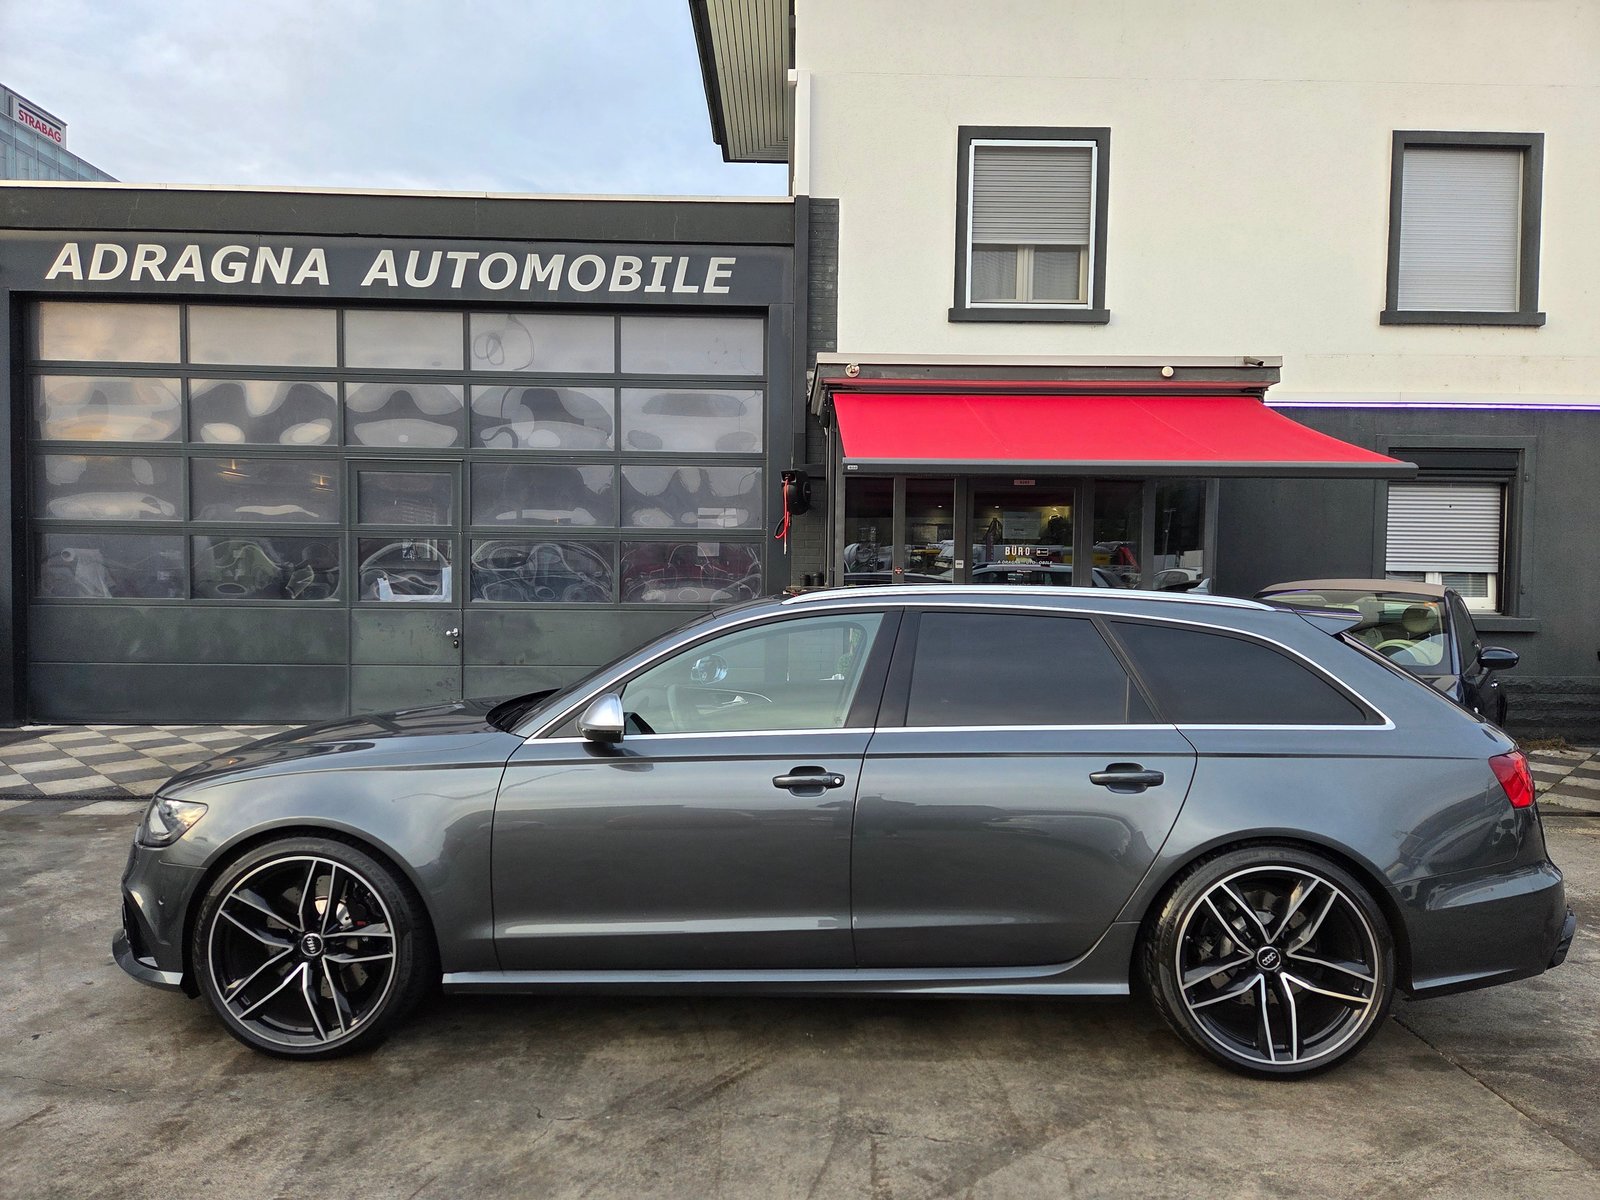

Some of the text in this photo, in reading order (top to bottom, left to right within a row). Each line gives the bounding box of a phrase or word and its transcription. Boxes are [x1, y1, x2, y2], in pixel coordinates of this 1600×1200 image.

[18, 109, 62, 143] STRABAG
[45, 242, 737, 294] ADRAGNA AUTOMOBILE
[1004, 544, 1031, 556] BÜRO
